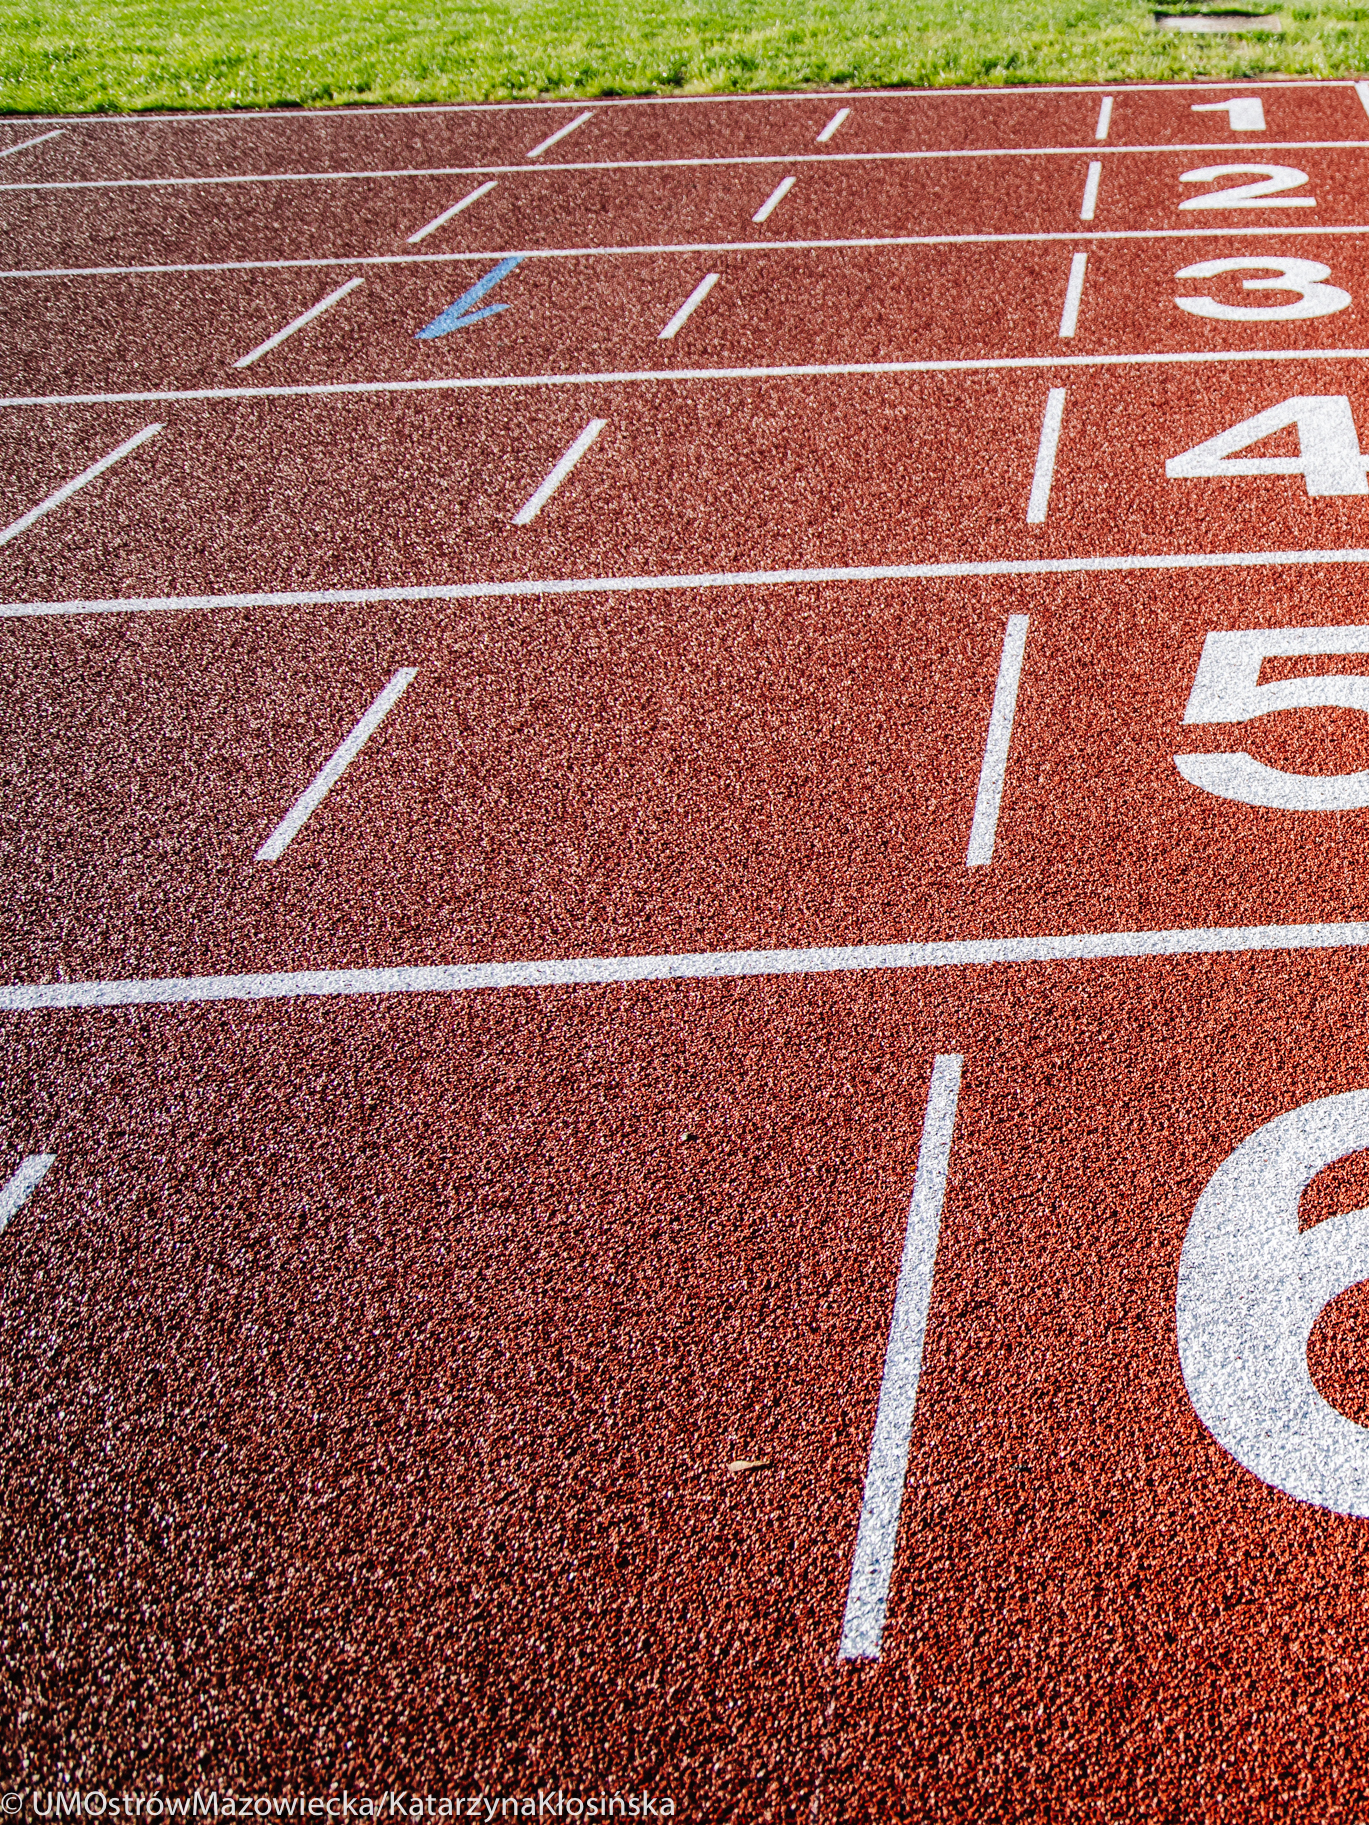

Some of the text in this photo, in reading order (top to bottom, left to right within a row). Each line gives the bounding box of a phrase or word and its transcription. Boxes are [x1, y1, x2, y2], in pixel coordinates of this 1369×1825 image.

[1190, 97, 1267, 132] 1
[1177, 162, 1317, 211] 2
[1173, 253, 1353, 322] 3
